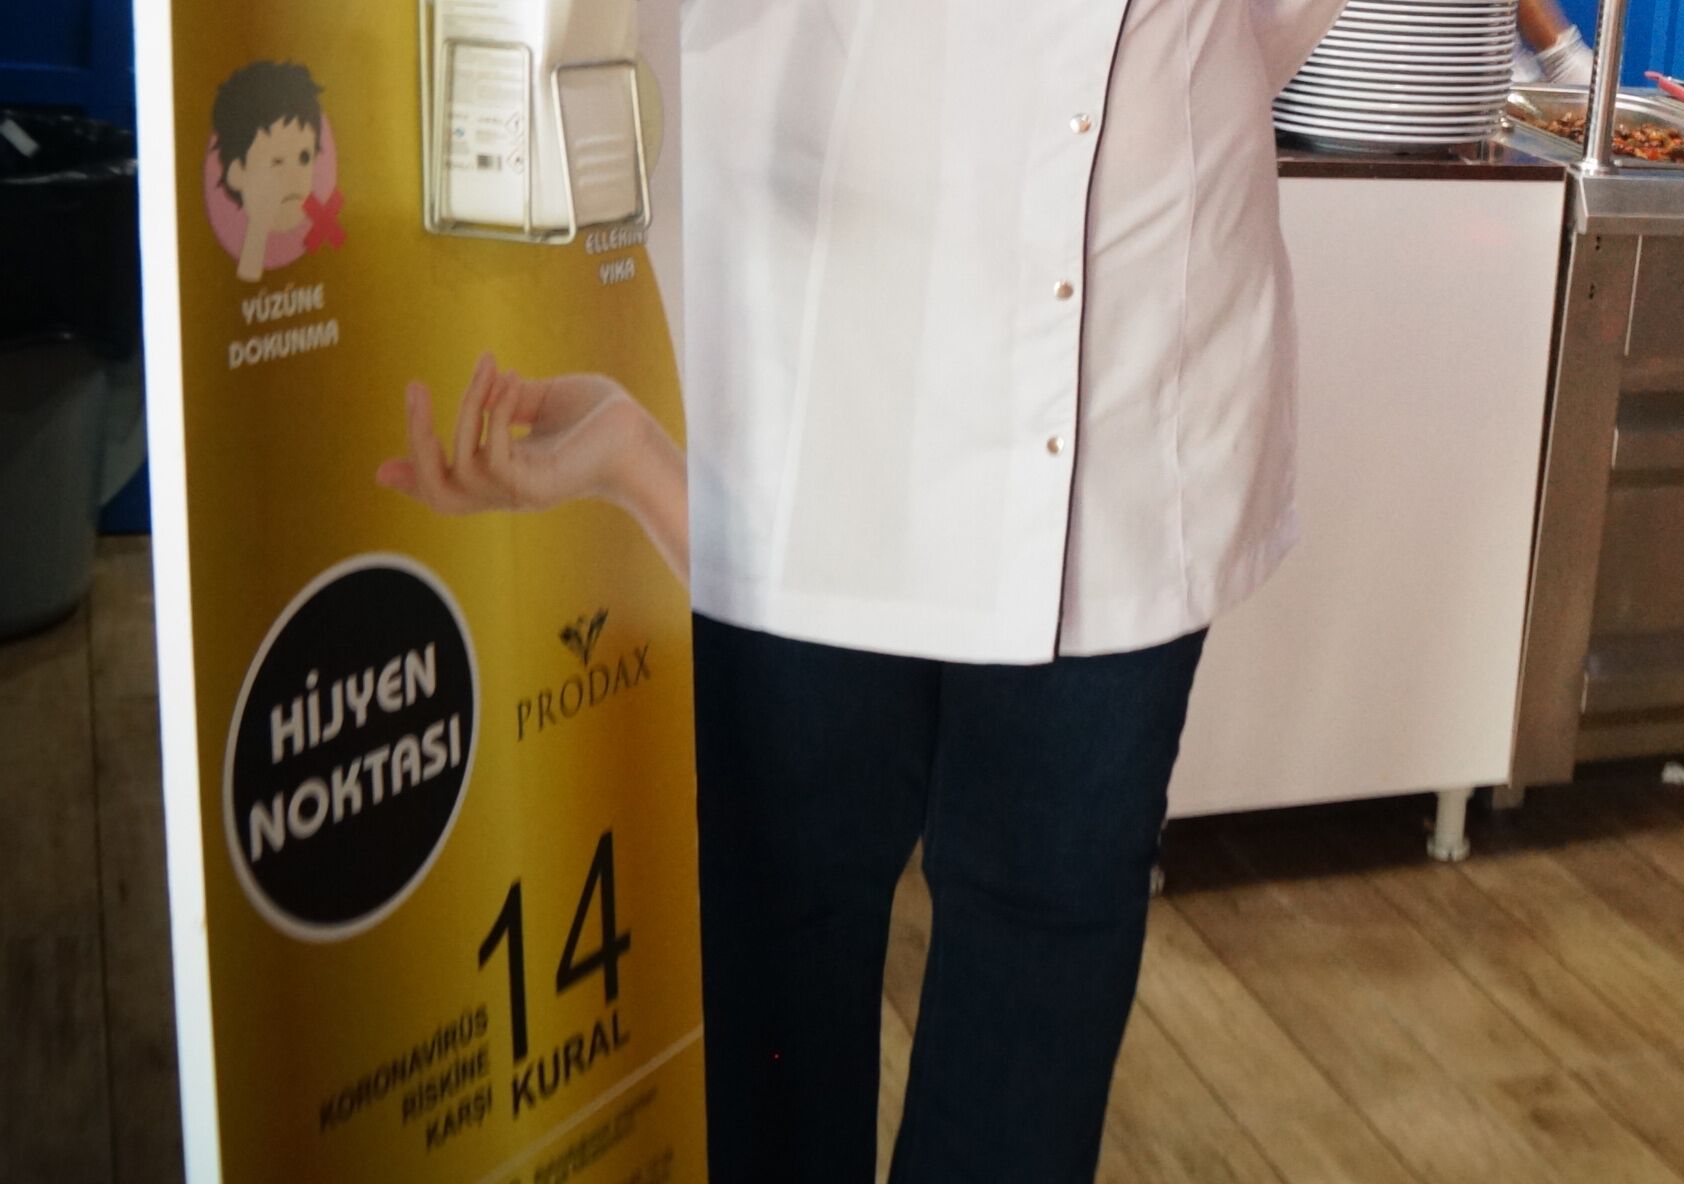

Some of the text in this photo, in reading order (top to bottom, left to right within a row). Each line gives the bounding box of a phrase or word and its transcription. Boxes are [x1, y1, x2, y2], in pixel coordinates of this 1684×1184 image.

[228, 318, 340, 371] DOKUNMA
[269, 641, 438, 766] HİJYEN
[516, 641, 652, 742] PRODAX
[247, 712, 462, 865] NOKTASI
[477, 826, 632, 1066] 14
[318, 1003, 489, 1133] KORONAVİRÜS
[401, 1042, 490, 1126] RİSKİNE
[425, 1082, 494, 1152] KARŞI
[511, 1008, 631, 1121] KURAL
